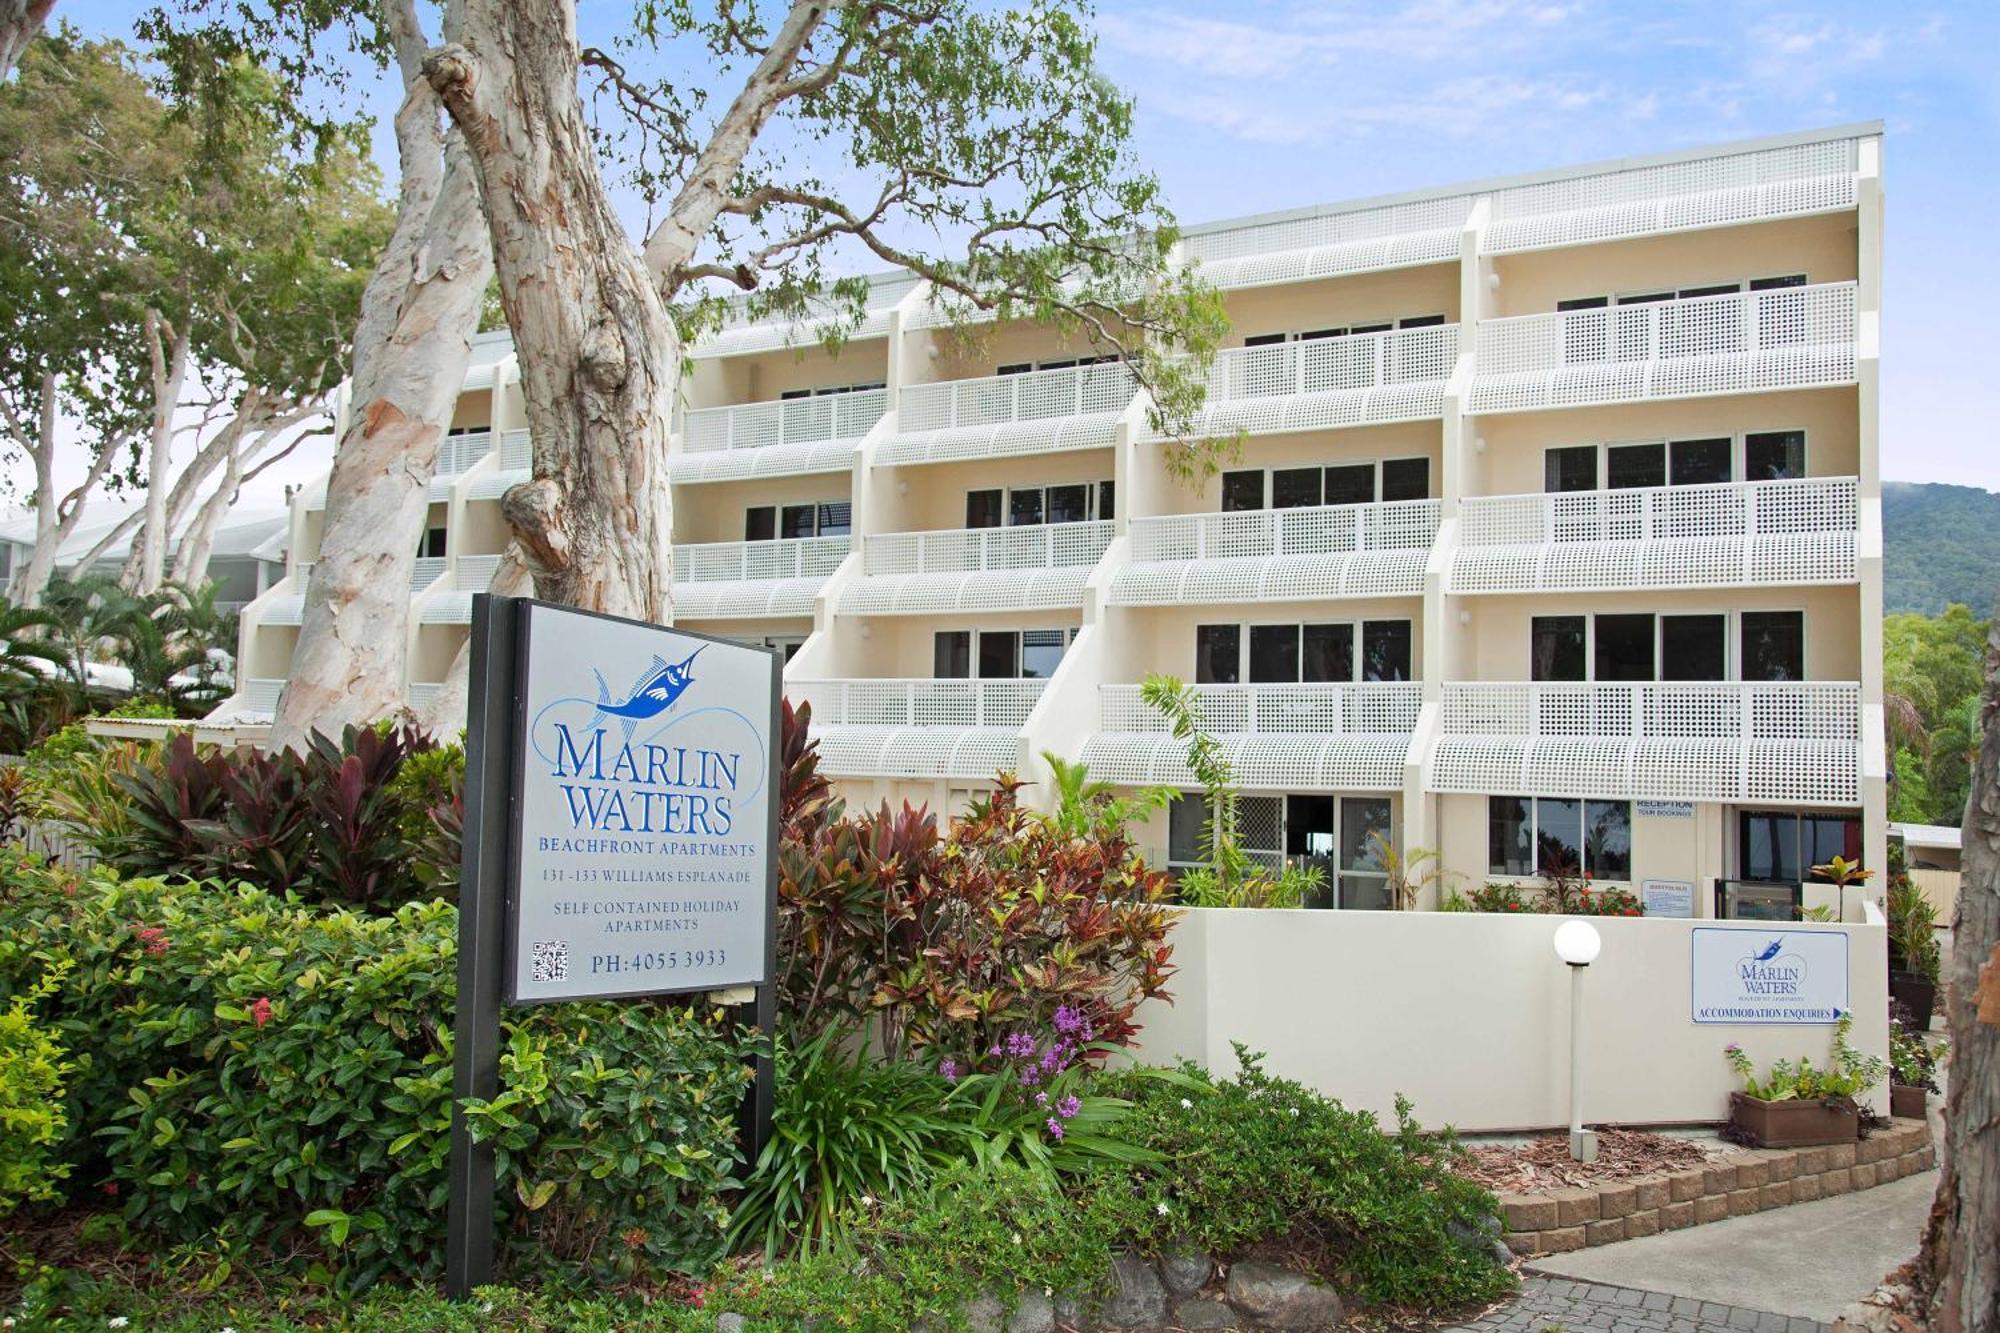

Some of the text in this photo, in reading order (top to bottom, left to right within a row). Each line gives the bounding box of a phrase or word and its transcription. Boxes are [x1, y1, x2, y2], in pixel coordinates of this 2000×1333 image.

[551, 723, 740, 791] MARLIN
[560, 784, 732, 836] WATERS
[539, 837, 756, 857] BEACHFRONT APARTMENTS
[602, 870, 673, 882] WILLIAMS
[677, 871, 751, 883] ESPLANADE
[553, 900, 740, 915] SELF CONTAINED HOLIDAY
[604, 918, 699, 933] APARTMENTS
[684, 949, 726, 968] 3933
[1741, 964, 1798, 981] MARLIN
[1744, 981, 1797, 994] WATERS
[1699, 1008, 1830, 1020] ACCOMMODATION ENQUIRIES
